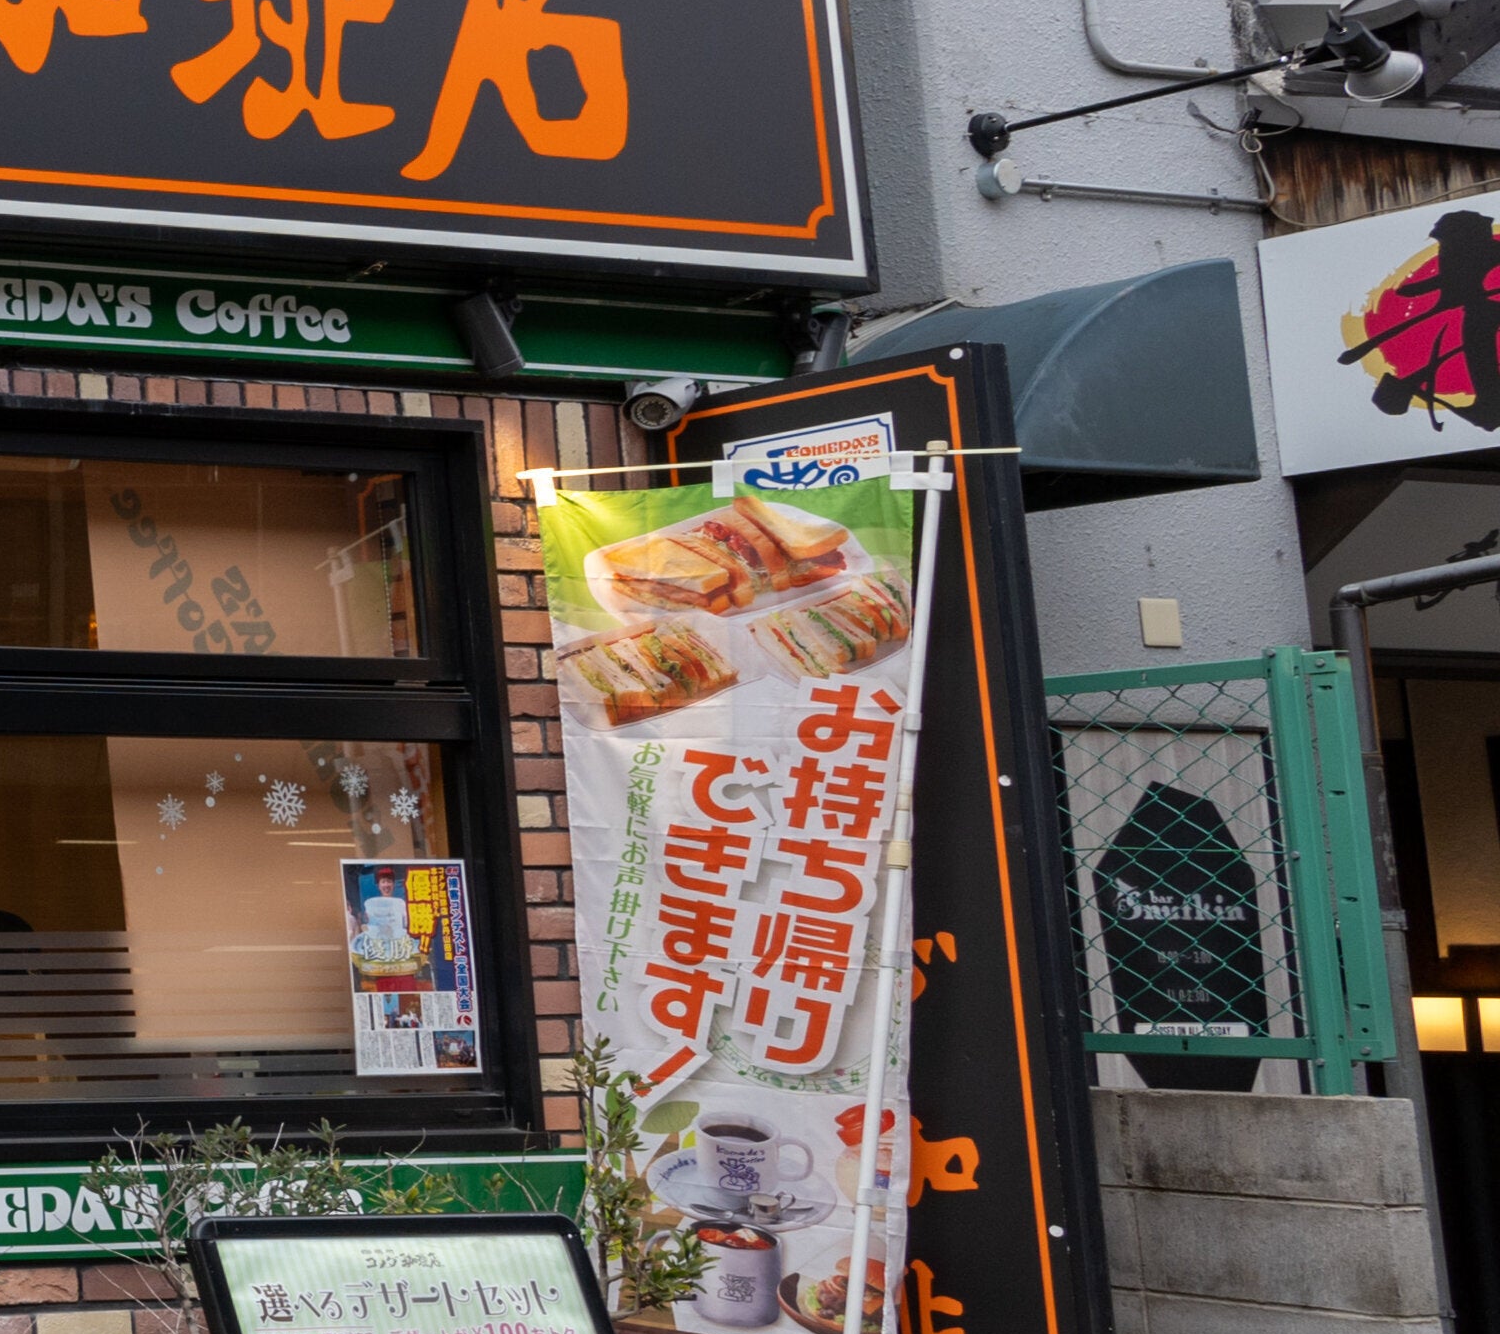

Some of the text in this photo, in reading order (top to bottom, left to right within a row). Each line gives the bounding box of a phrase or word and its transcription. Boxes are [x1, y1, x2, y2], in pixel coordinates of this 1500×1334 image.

[176, 289, 353, 345] Coffee
[785, 433, 880, 458] KOMEDA'S
[597, 741, 666, 1013] お気軽にお声掛け下さい
[744, 684, 903, 1065] お持ち帰り
[1148, 890, 1175, 904] bar
[363, 935, 414, 961] 優勝
[633, 748, 770, 1097] できます!
[252, 1278, 561, 1324] 選べるデザートセット
